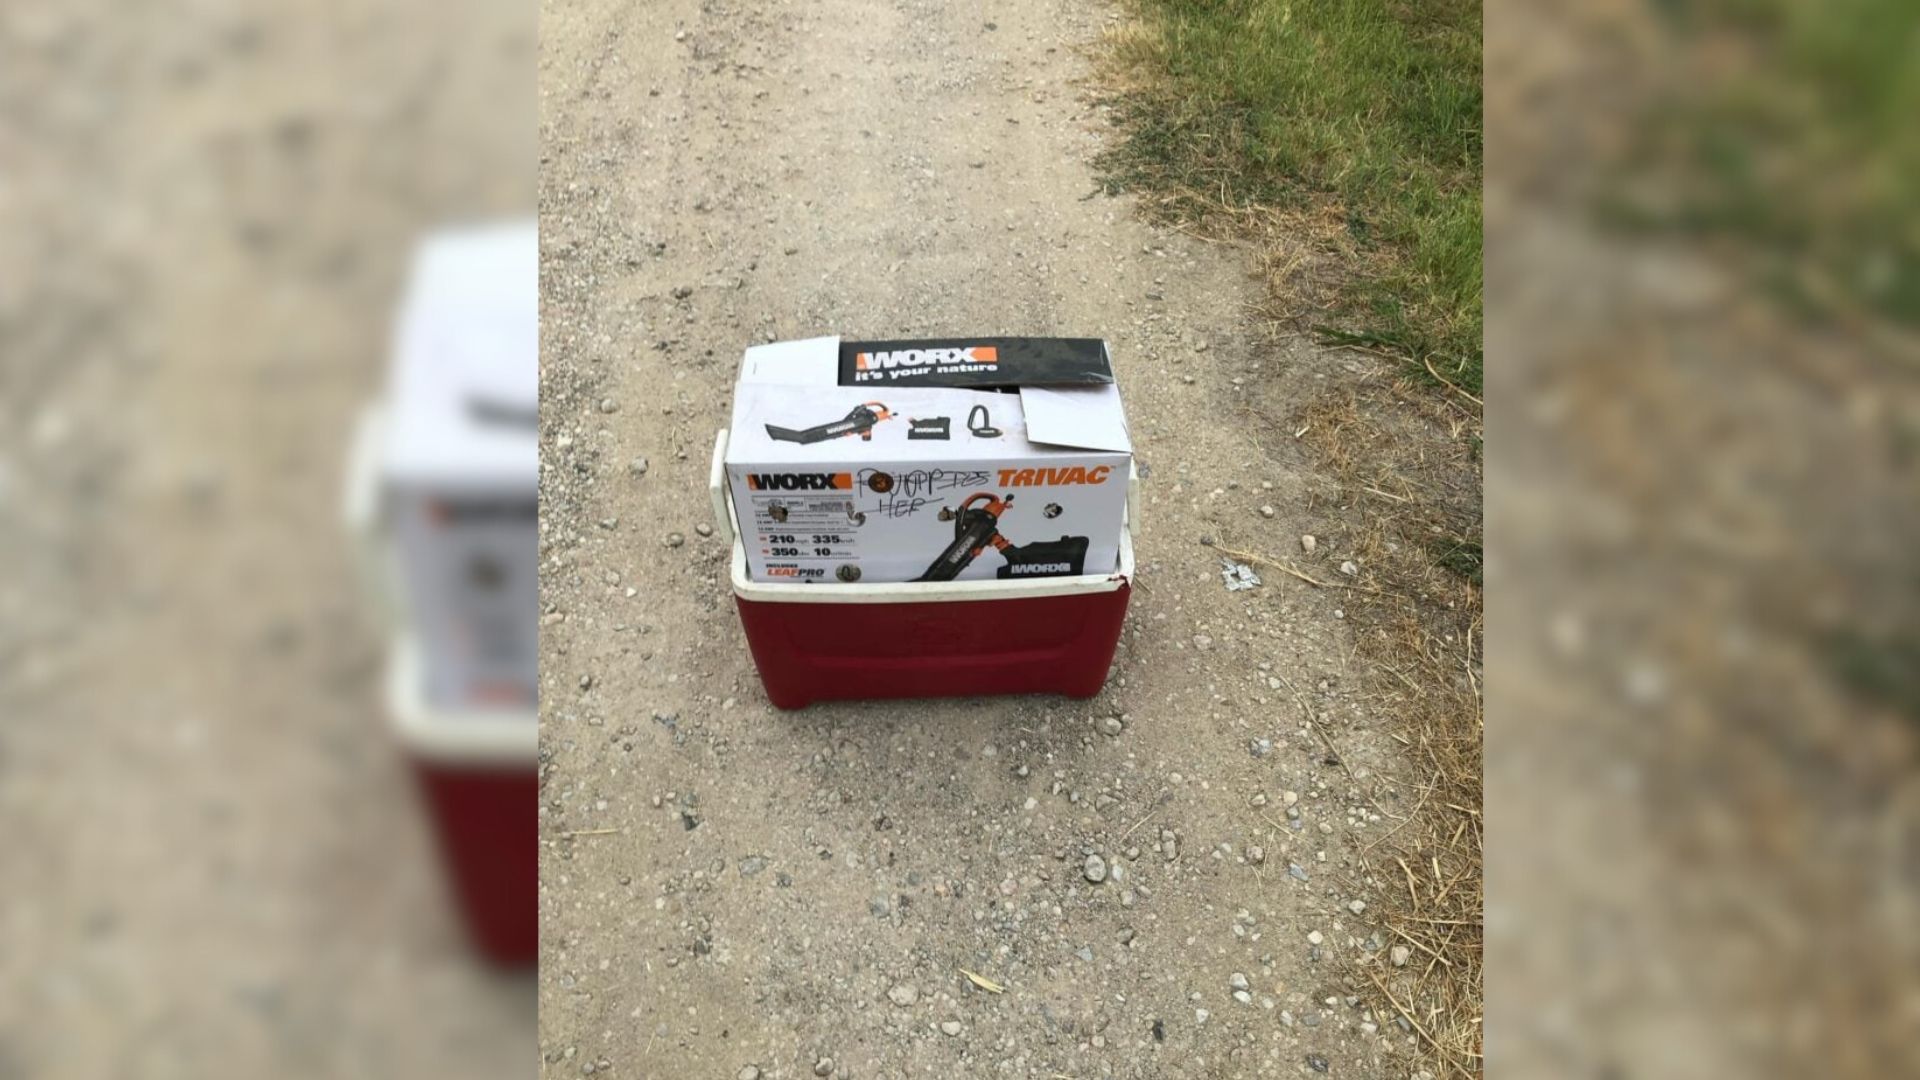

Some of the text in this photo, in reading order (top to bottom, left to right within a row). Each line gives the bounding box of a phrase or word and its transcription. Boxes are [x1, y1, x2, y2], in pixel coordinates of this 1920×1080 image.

[860, 347, 978, 370] WORX
[855, 364, 998, 381] it's your nature
[754, 473, 839, 490] WORX
[997, 465, 1110, 487] TRIVAC
[769, 535, 796, 544] 210
[812, 535, 840, 544] 335
[771, 547, 799, 556] 350
[814, 547, 831, 556] 10
